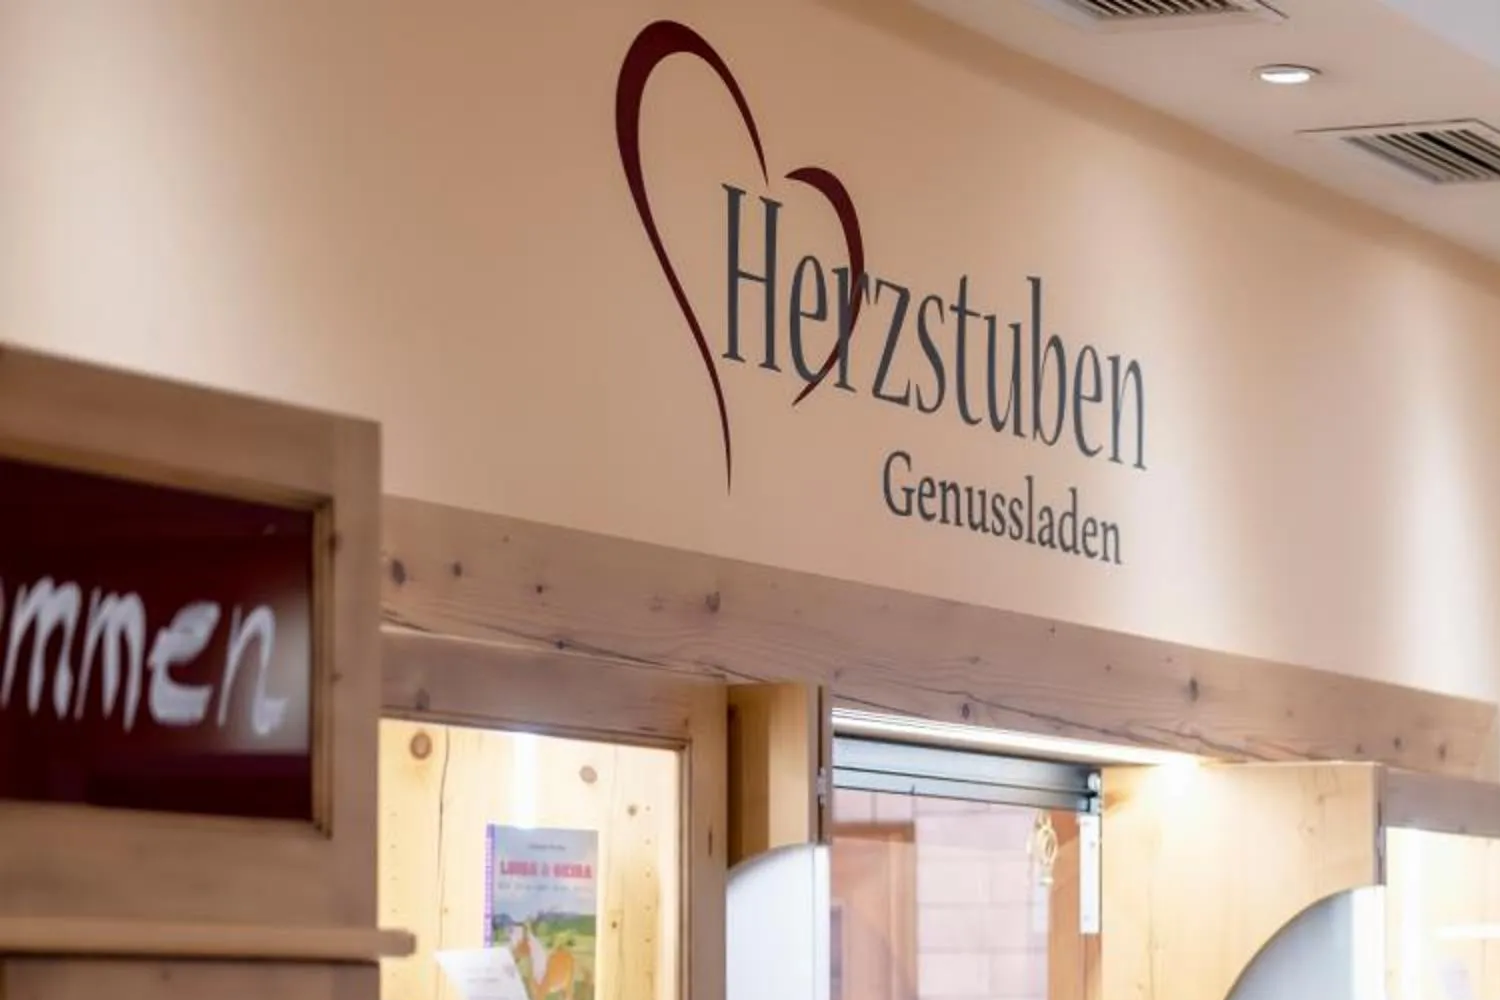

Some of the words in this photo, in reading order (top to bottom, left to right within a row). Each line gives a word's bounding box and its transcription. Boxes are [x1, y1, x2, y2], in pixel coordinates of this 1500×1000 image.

[721, 183, 1147, 470] Herzstuben
[882, 451, 1122, 565] Genussladen
[0, 575, 287, 735] mmen
